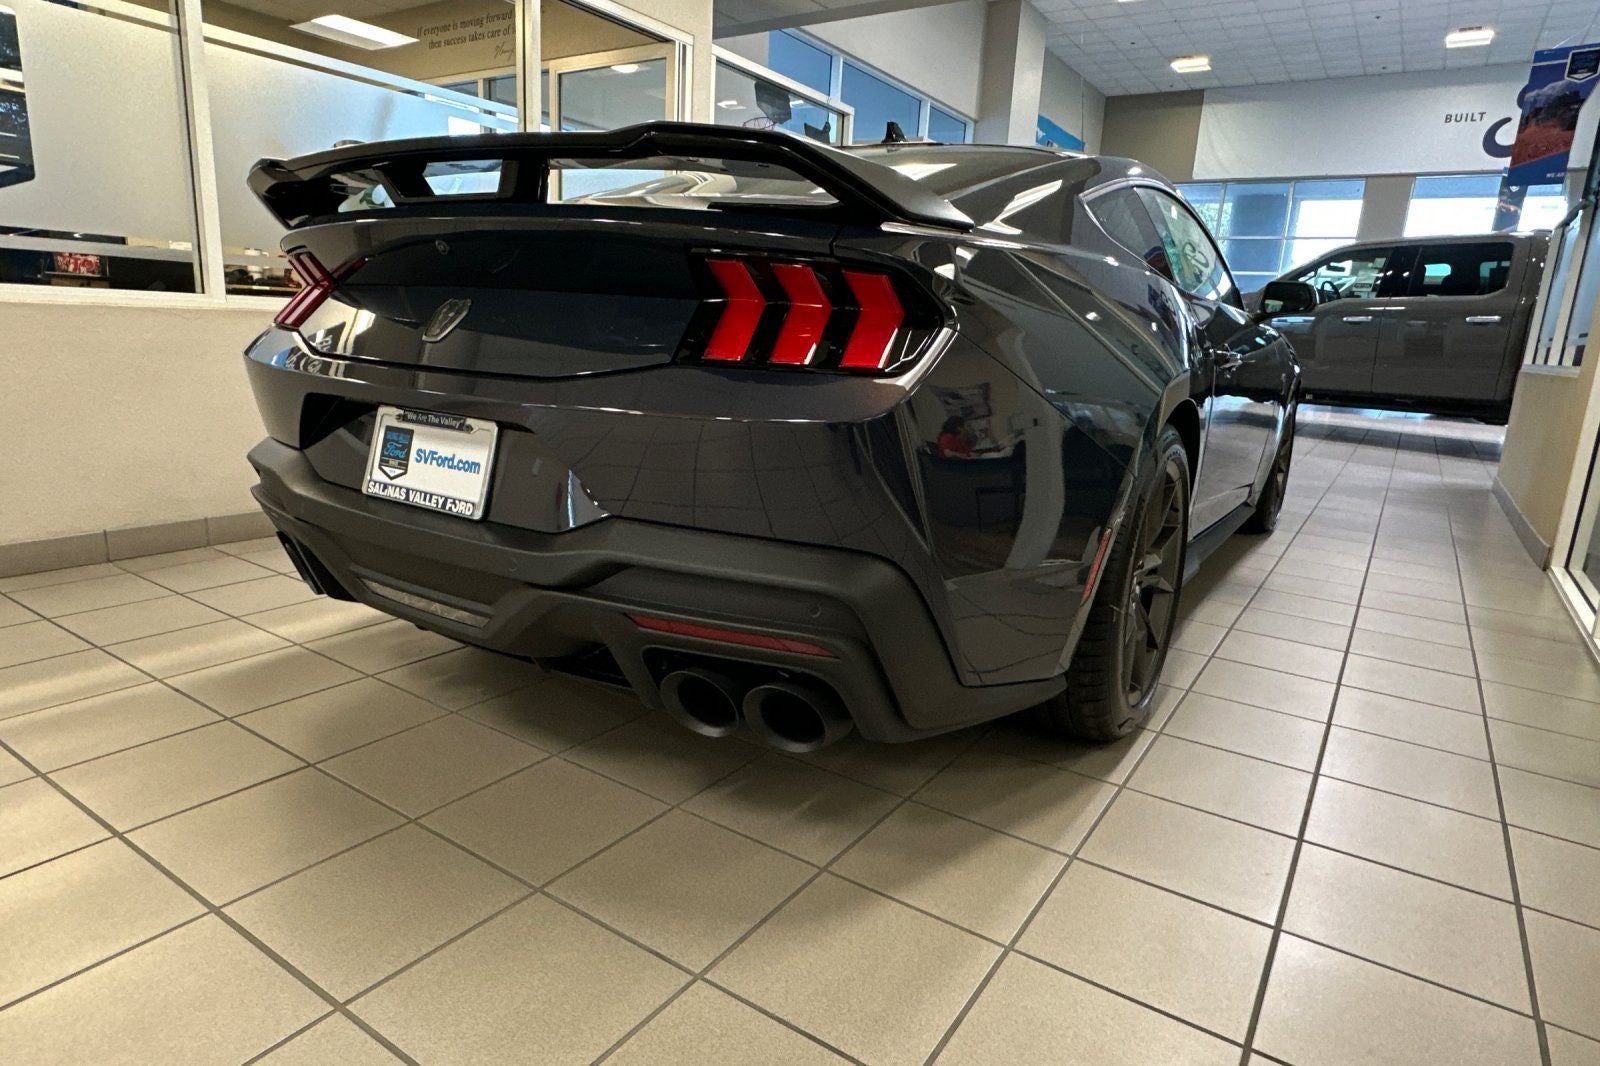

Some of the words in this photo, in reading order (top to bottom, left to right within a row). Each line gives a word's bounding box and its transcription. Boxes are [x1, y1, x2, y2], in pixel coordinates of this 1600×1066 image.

[423, 23, 451, 36] everyone
[452, 22, 459, 31] is
[460, 17, 484, 27] moving
[486, 10, 512, 24] forward
[428, 39, 441, 49] then
[443, 35, 467, 46] success
[468, 30, 485, 43] takes
[487, 28, 501, 39] care
[502, 24, 511, 36] of
[1444, 112, 1487, 123] BUILT
[428, 414, 440, 424] The
[383, 441, 408, 458] Ford
[415, 448, 481, 475] SVFord.com
[368, 481, 406, 500] SALINAS
[408, 489, 445, 508] VALLEY
[446, 499, 474, 516] FORD
